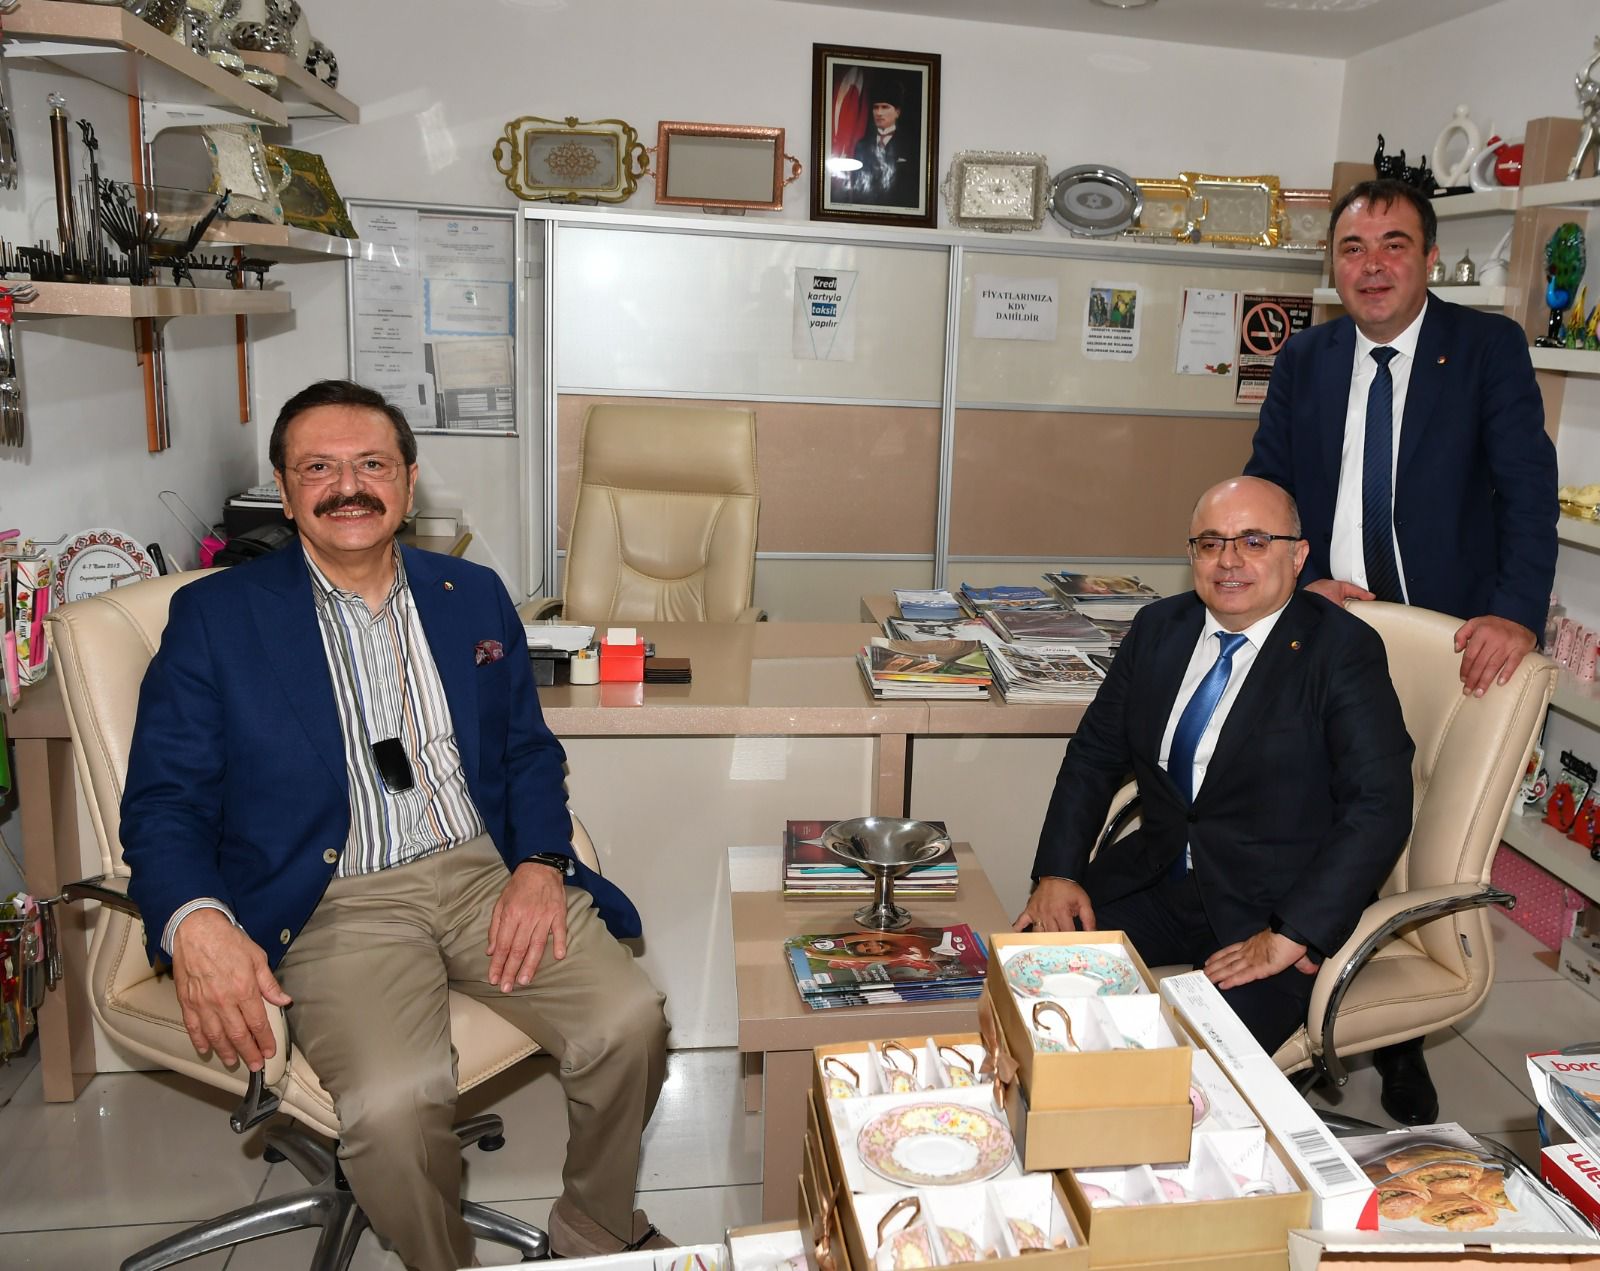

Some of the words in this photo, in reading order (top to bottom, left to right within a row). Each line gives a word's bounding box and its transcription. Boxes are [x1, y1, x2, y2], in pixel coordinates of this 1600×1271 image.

[813, 278, 837, 289] Kredi
[808, 292, 841, 302] kartıyla
[982, 289, 1052, 302] FİYATLARIMIZA
[812, 305, 836, 315] taksit
[1008, 302, 1027, 311] KDV
[995, 312, 1039, 322] DAHİLDİR
[810, 319, 838, 328] yapılır
